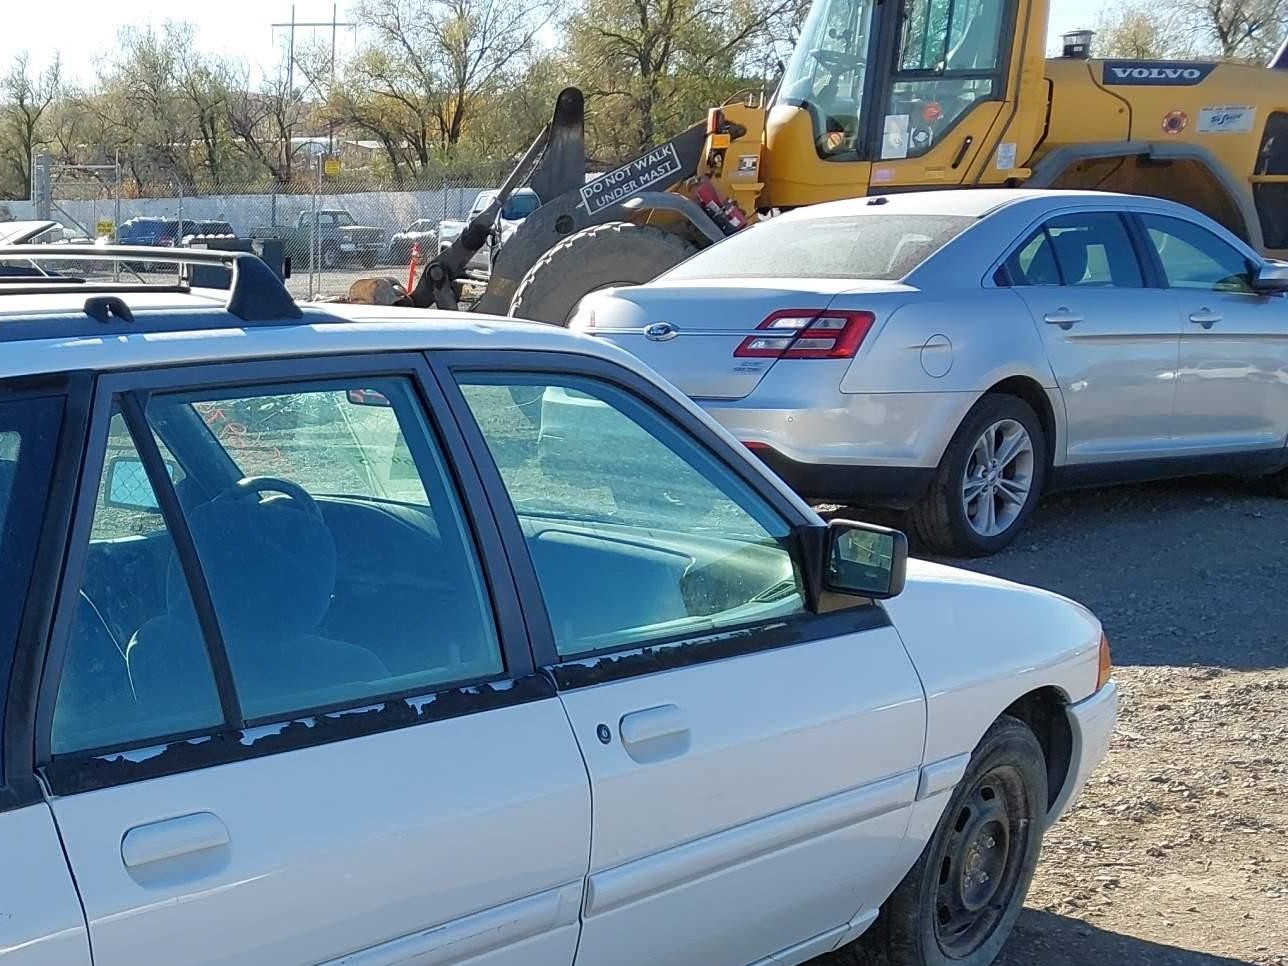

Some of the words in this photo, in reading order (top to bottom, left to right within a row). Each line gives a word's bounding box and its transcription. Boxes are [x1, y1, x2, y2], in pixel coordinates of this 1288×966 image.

[1112, 67, 1201, 79] VOLVO
[583, 183, 603, 199] DO
[605, 166, 632, 187] NOT
[634, 145, 672, 170] WALK
[596, 180, 638, 207] UNDER
[639, 161, 672, 184] MAST
